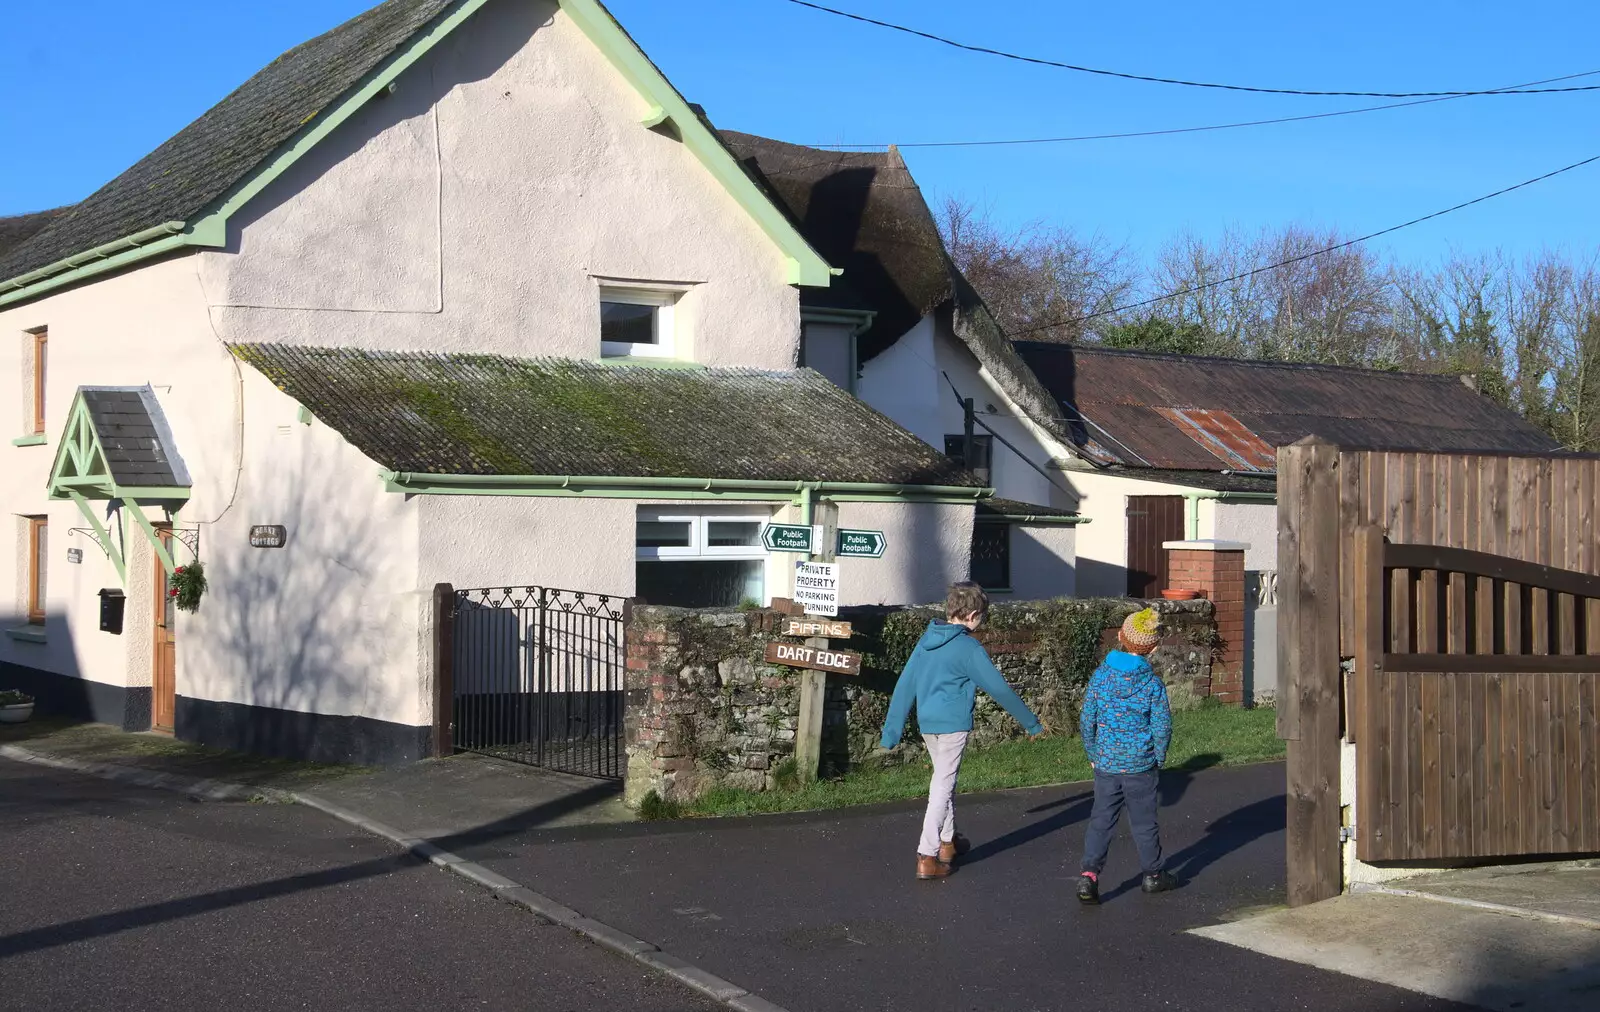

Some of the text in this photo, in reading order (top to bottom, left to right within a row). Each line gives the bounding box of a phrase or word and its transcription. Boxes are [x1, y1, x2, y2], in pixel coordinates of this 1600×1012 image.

[783, 530, 803, 538] Public
[777, 538, 807, 548] Footpath
[847, 536, 868, 544] Public
[842, 543, 871, 552] Footpath
[801, 565, 831, 575] PRIVATE
[797, 576, 836, 587] PROPERTY
[796, 590, 835, 601] NO PARKING
[804, 602, 835, 612] TURNING
[788, 621, 844, 636] PIPPINS
[777, 645, 851, 668] DART EDGE
